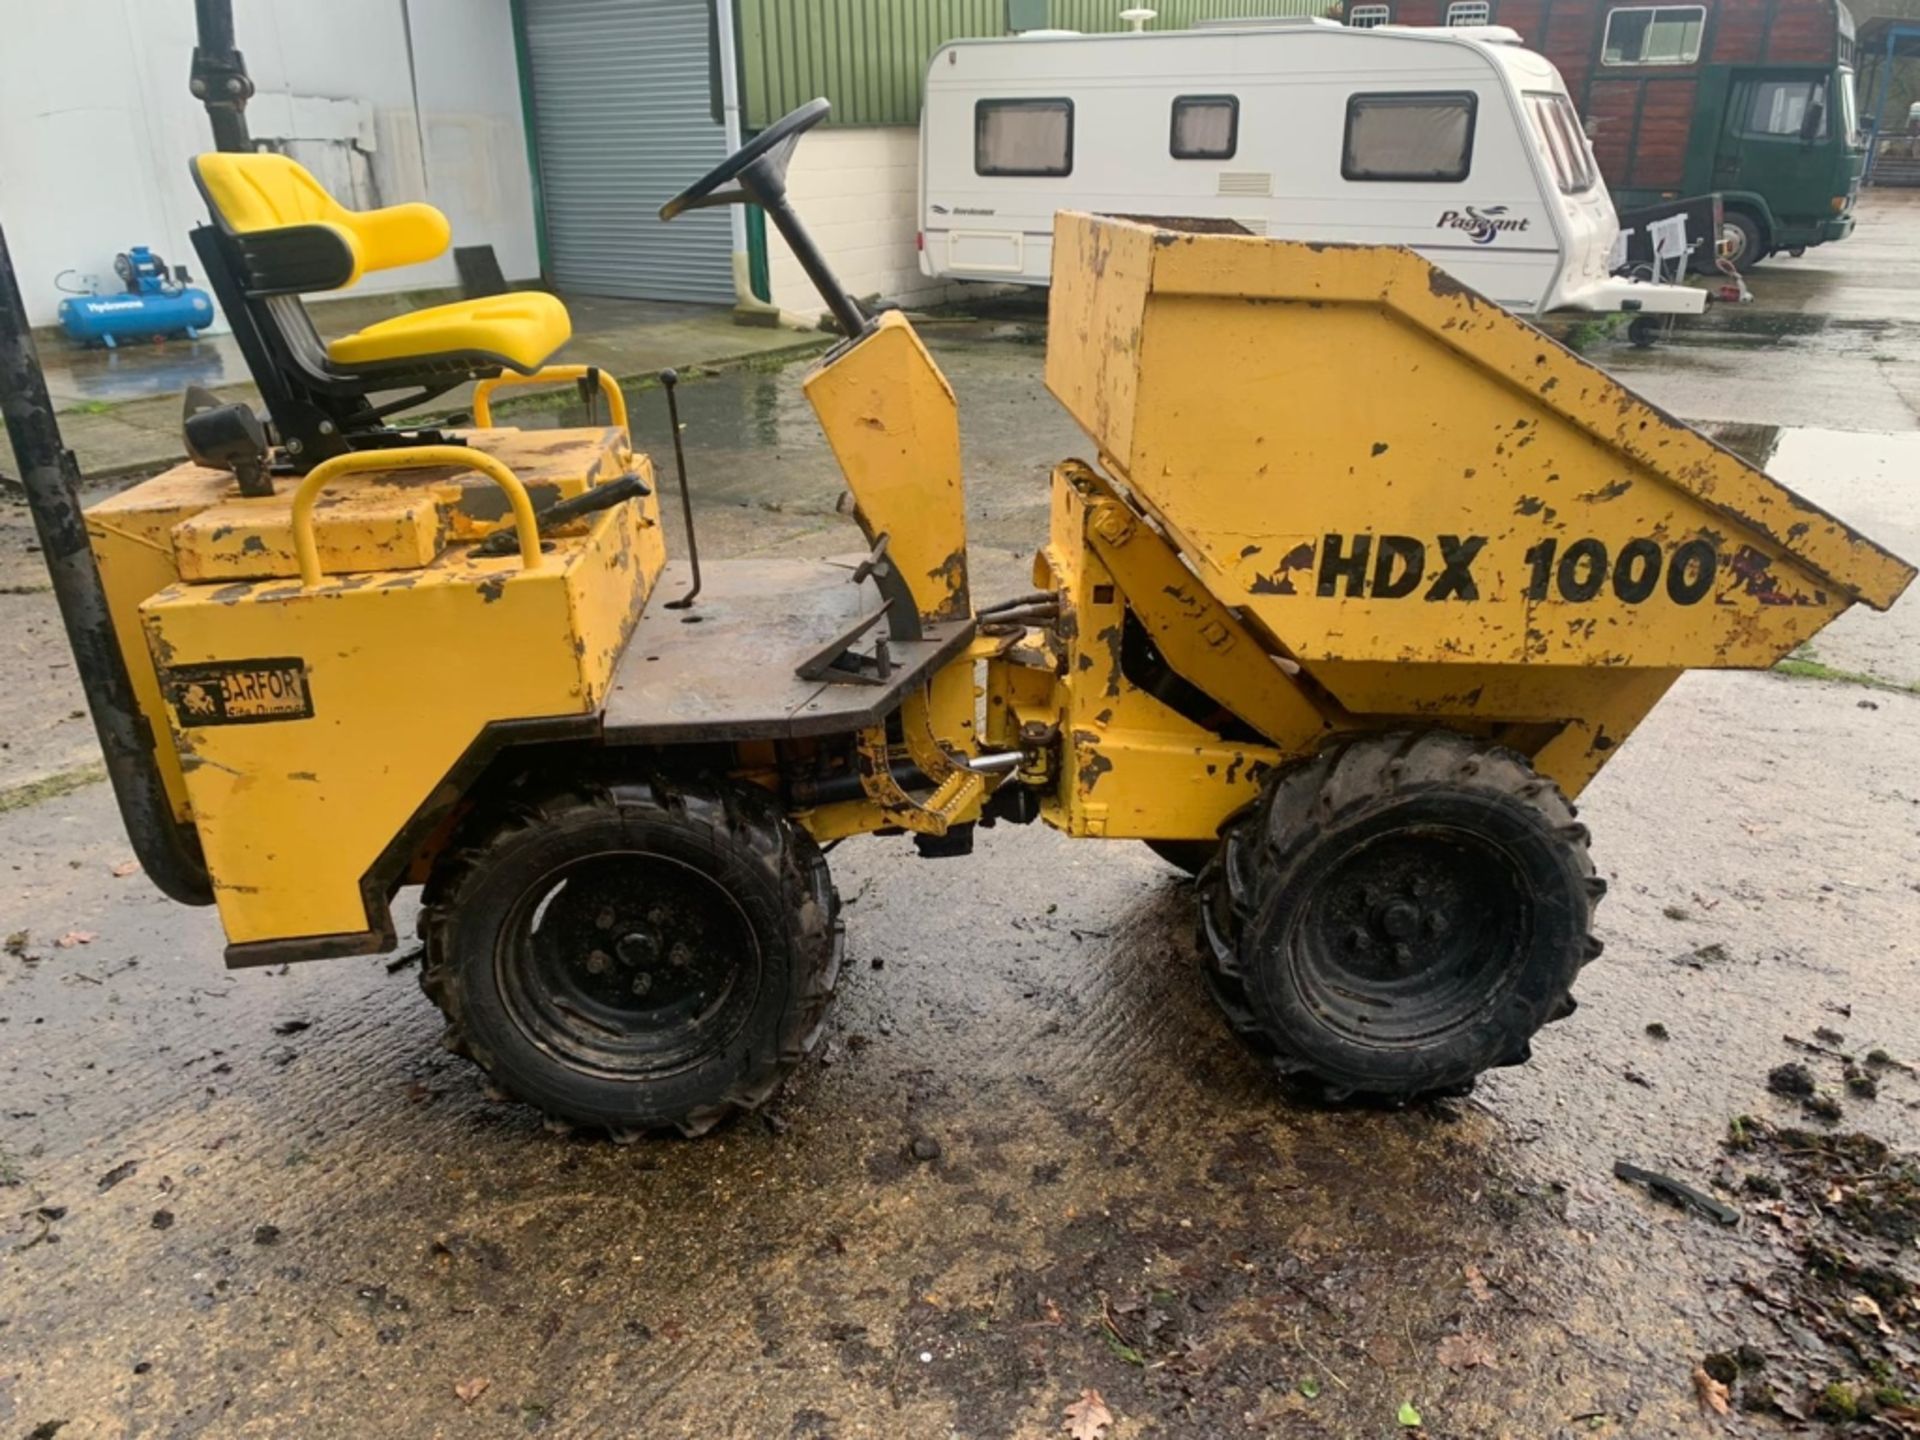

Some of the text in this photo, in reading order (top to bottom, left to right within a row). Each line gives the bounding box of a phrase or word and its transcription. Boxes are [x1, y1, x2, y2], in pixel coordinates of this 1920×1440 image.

[1436, 210, 1530, 236] Pageant
[1316, 534, 1720, 606] HDX 1000
